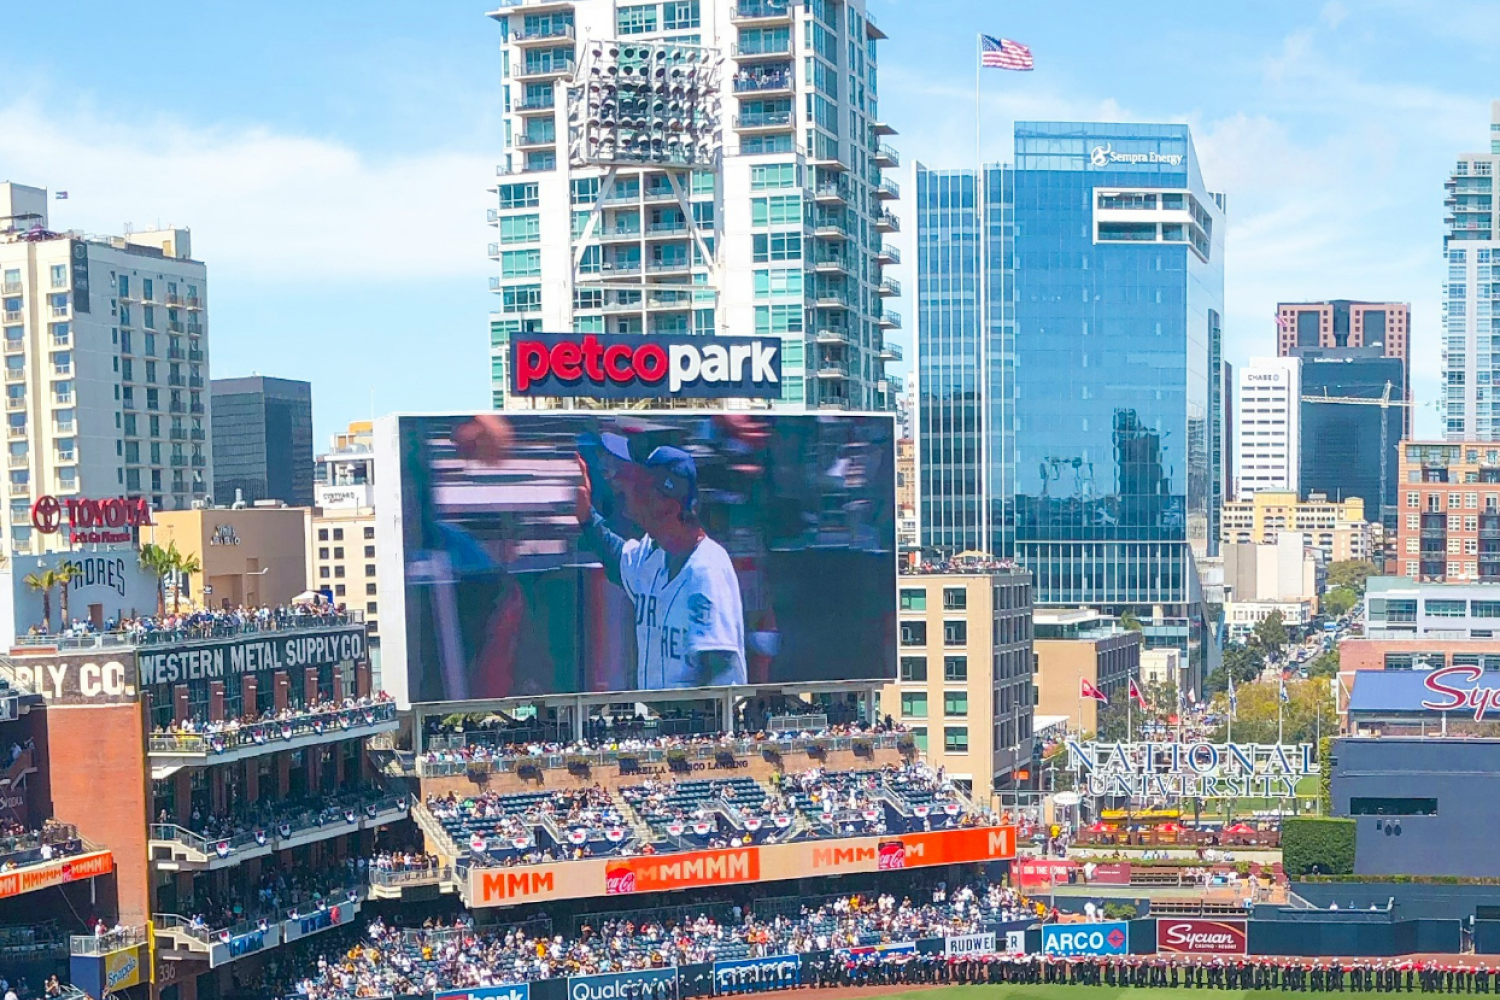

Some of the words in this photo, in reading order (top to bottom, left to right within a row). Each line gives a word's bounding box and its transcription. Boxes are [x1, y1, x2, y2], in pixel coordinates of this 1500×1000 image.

[1110, 152, 1148, 165] Sempra
[1149, 152, 1183, 165] Energy
[65, 498, 152, 528] TOYOTA
[139, 648, 224, 686] WESTERN
[230, 642, 282, 673] METAL
[286, 635, 338, 666] SUPPLY
[339, 632, 365, 661] CO.
[80, 661, 136, 698] CO.
[708, 760, 748, 771] LANDING
[1066, 741, 1320, 775] NATIONAL
[1086, 773, 1302, 798] UNIVERSITY
[988, 830, 1007, 856] M
[812, 847, 875, 868] MMM
[482, 871, 554, 901] MMM
[951, 934, 1018, 952] BUDWEIER
[1045, 931, 1104, 951] ARCO
[1166, 924, 1234, 949] Sycuan
[108, 955, 138, 988] Snapple
[158, 963, 175, 983] 336
